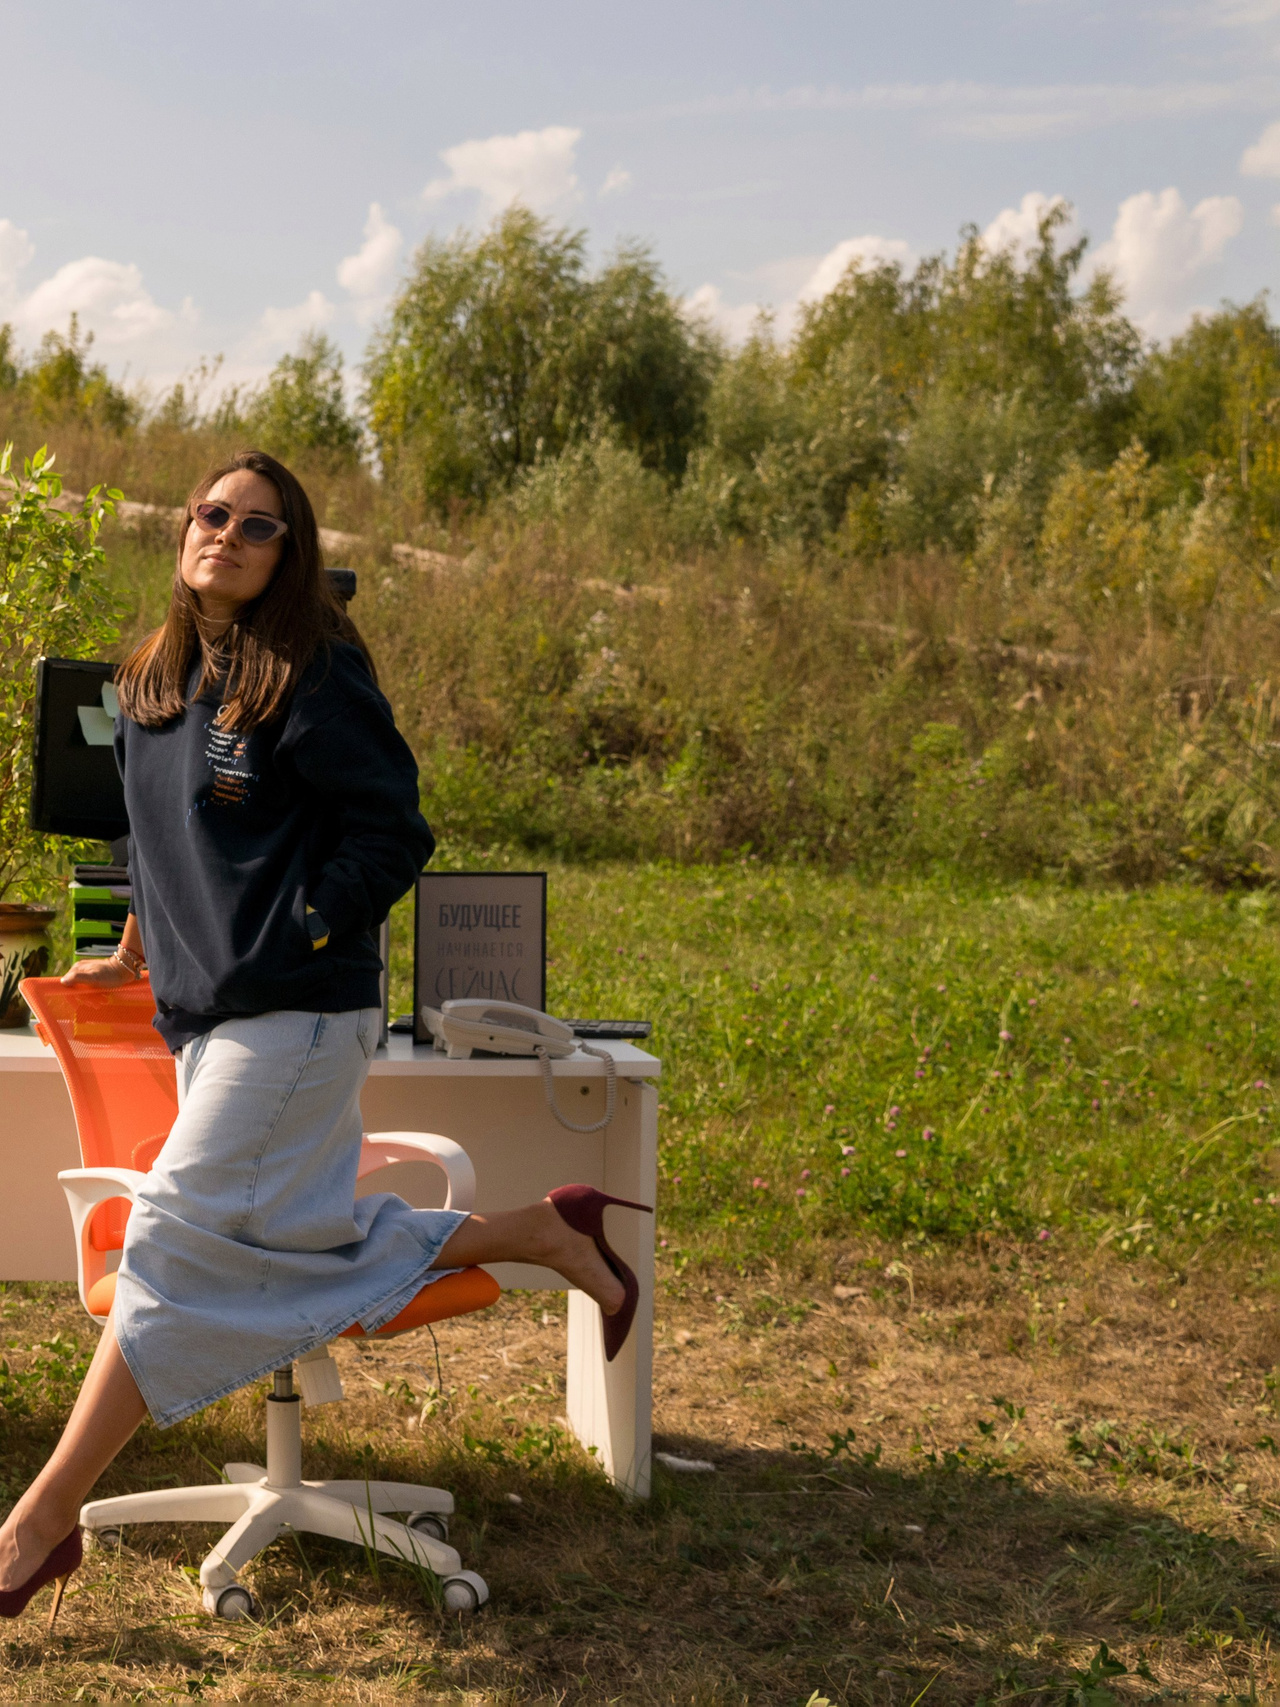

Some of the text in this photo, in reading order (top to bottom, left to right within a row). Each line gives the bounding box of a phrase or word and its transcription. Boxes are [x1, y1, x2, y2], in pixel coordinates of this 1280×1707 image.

[438, 904, 522, 932] БУДУЩЕЕ
[437, 941, 523, 958] НАЧИНАЕТСЯ
[435, 966, 524, 1001] СЕЙЧАС
